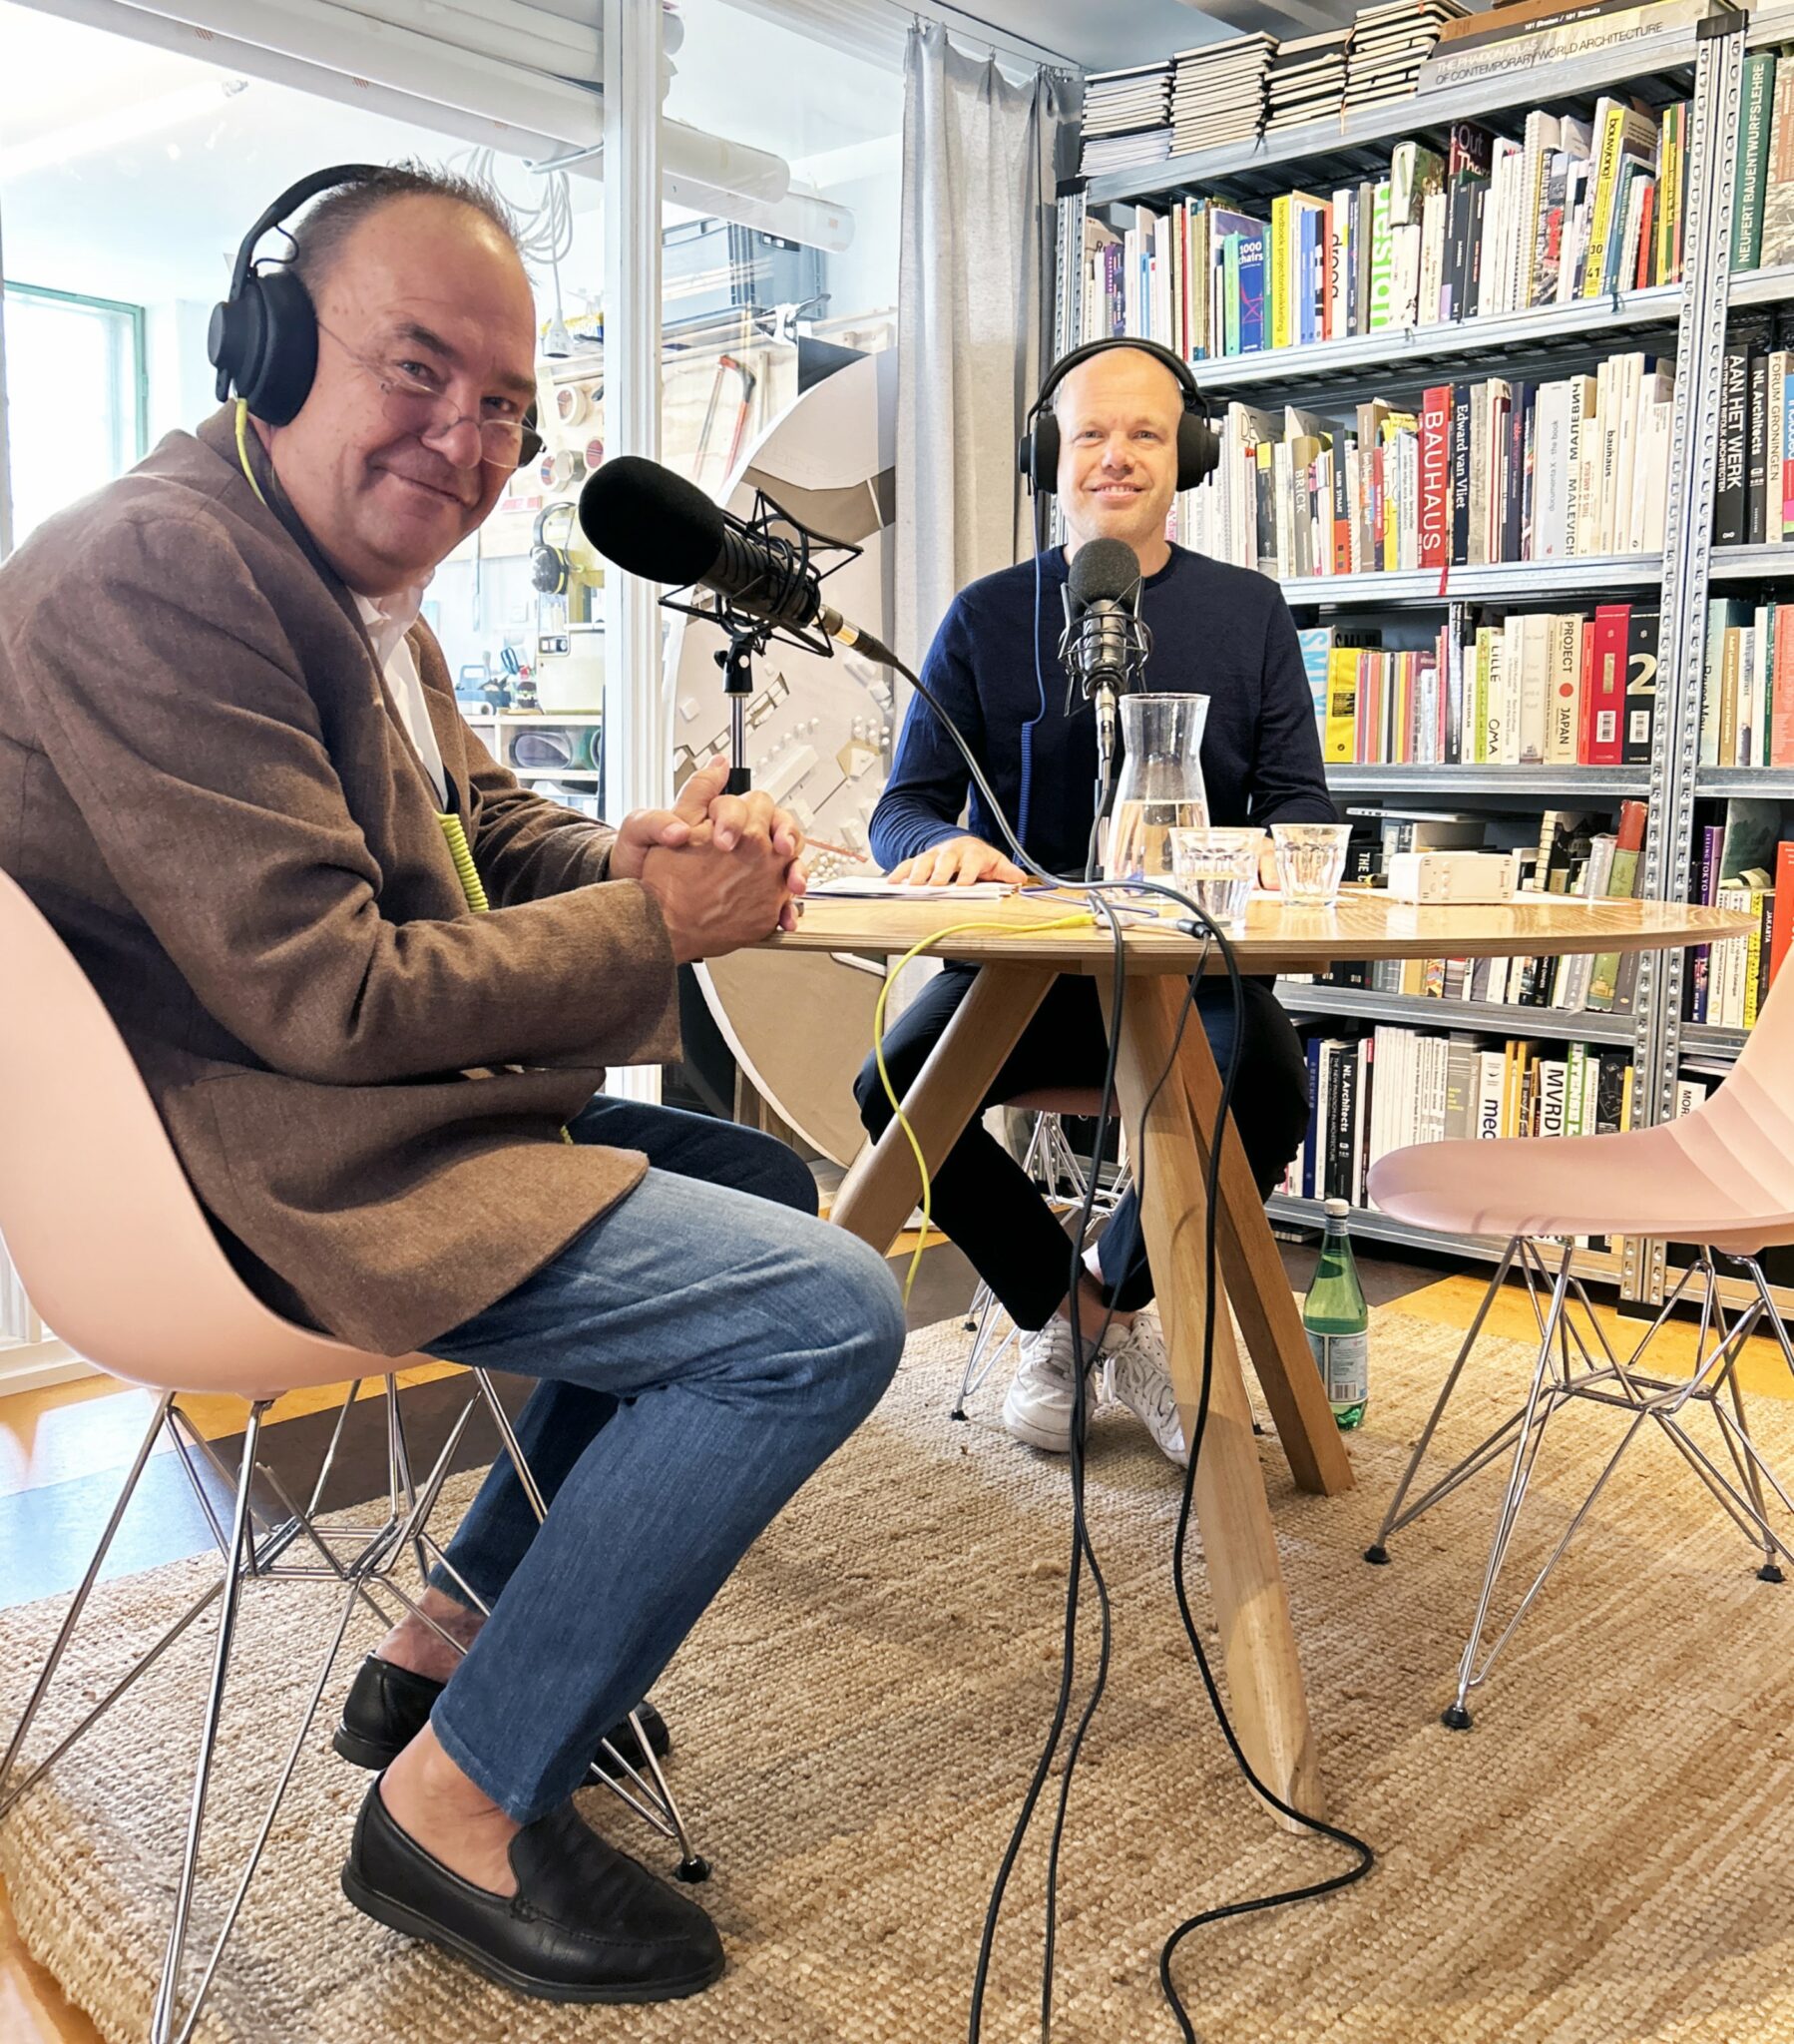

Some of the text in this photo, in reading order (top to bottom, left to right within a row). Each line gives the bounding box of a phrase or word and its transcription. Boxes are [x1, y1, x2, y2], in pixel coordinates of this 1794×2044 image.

[1449, 52, 1537, 82] CONTEMPORARY
[1537, 42, 1578, 61] WORLD
[1577, 22, 1664, 51] ARCHITECTURE
[1738, 63, 1764, 262] NEUFERT BAUENTWURFSLEHRE
[1238, 252, 1263, 264] chairs
[1239, 241, 1262, 255] 1000
[1277, 203, 1286, 246] handboek
[1570, 382, 1580, 460] МАЛЕВИЧ
[1727, 355, 1744, 488] AAN HET WERK
[1751, 369, 1764, 455] NL Architects
[1770, 356, 1781, 481] FORUM GRONINGEN
[1423, 410, 1444, 551] BAUHAUS
[1456, 403, 1469, 509] Edward van Vliet
[1604, 430, 1615, 477] bauhaus
[1295, 469, 1306, 513] BRICK
[1566, 478, 1576, 555] MALEVICH
[1489, 646, 1502, 755] LILLE OMA
[1560, 621, 1573, 745] PROJECT JAPAN
[1626, 653, 1657, 696] 2
[1358, 852, 1370, 872] THE
[1701, 861, 1710, 891] TOKYO
[1340, 1065, 1352, 1132] NL Architects
[1680, 1090, 1692, 1118] MOR
